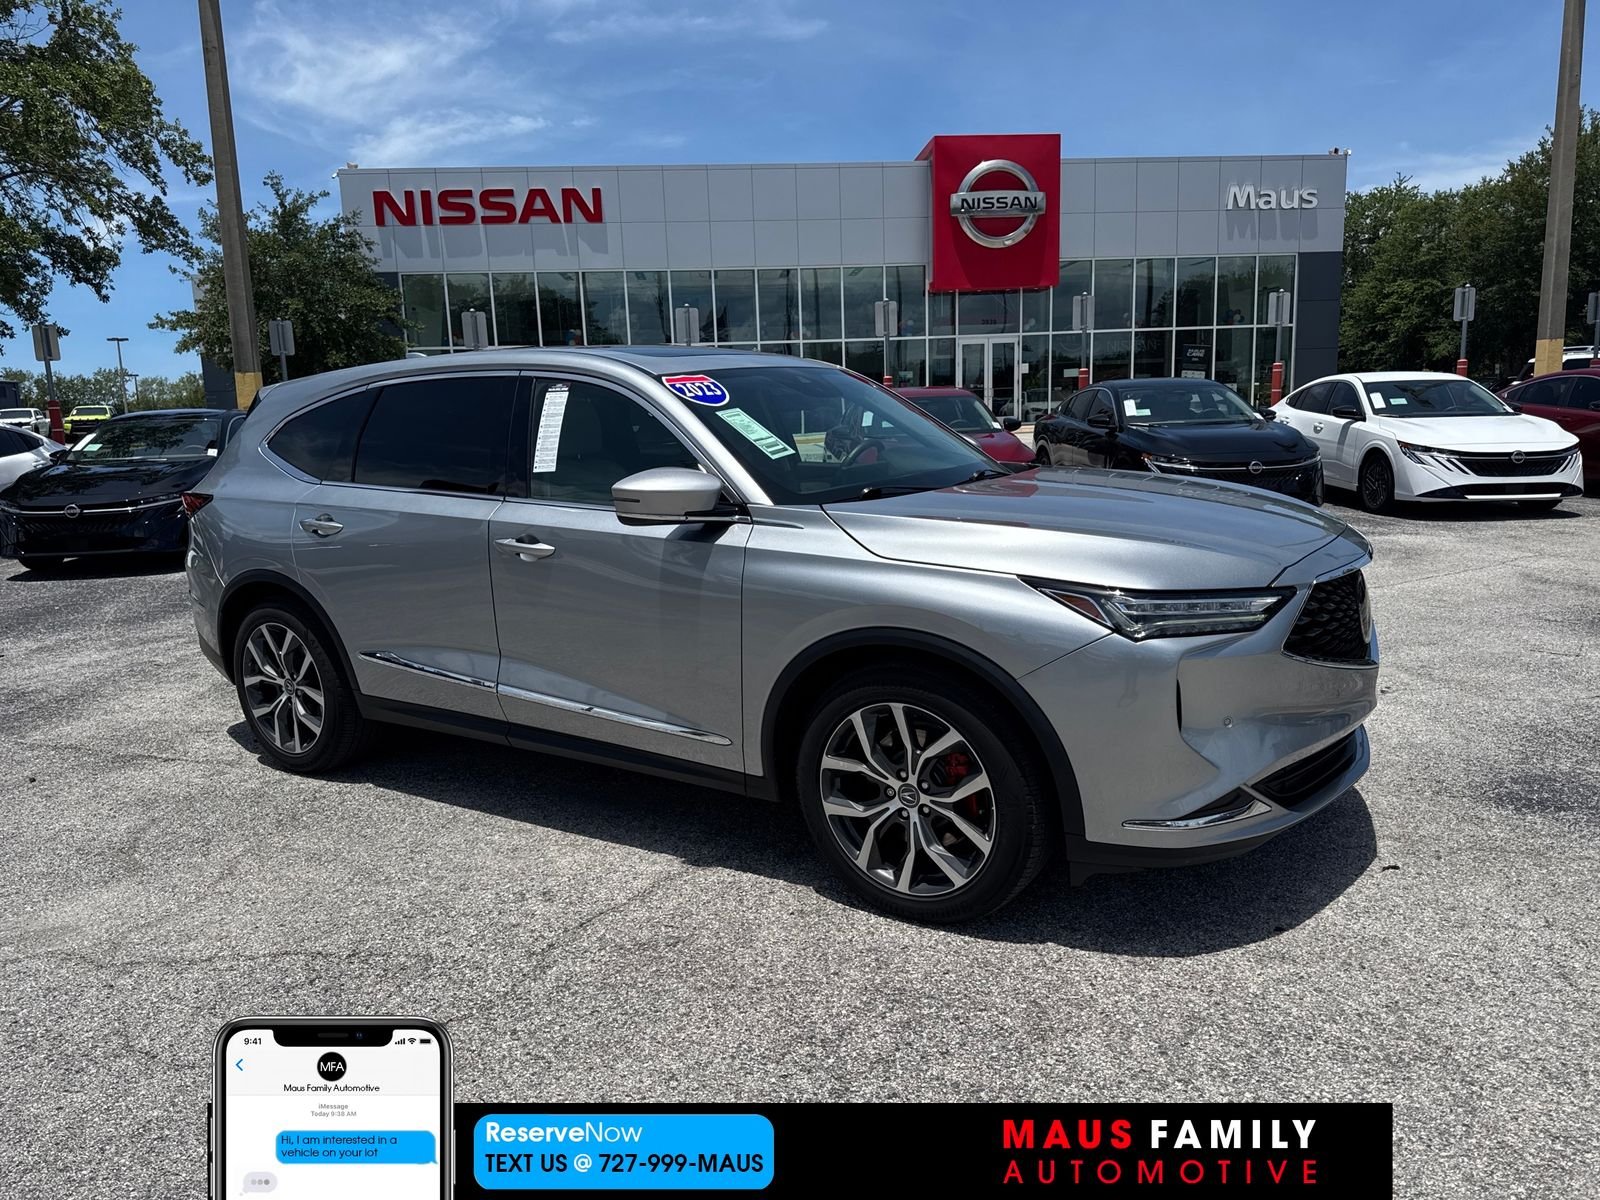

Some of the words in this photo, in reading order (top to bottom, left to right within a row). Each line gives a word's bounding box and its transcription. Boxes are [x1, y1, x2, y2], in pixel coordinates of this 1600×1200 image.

[373, 186, 603, 226] NISSAN
[961, 196, 1038, 210] NISSAN
[1226, 184, 1318, 210] Maus
[676, 382, 722, 398] 2023
